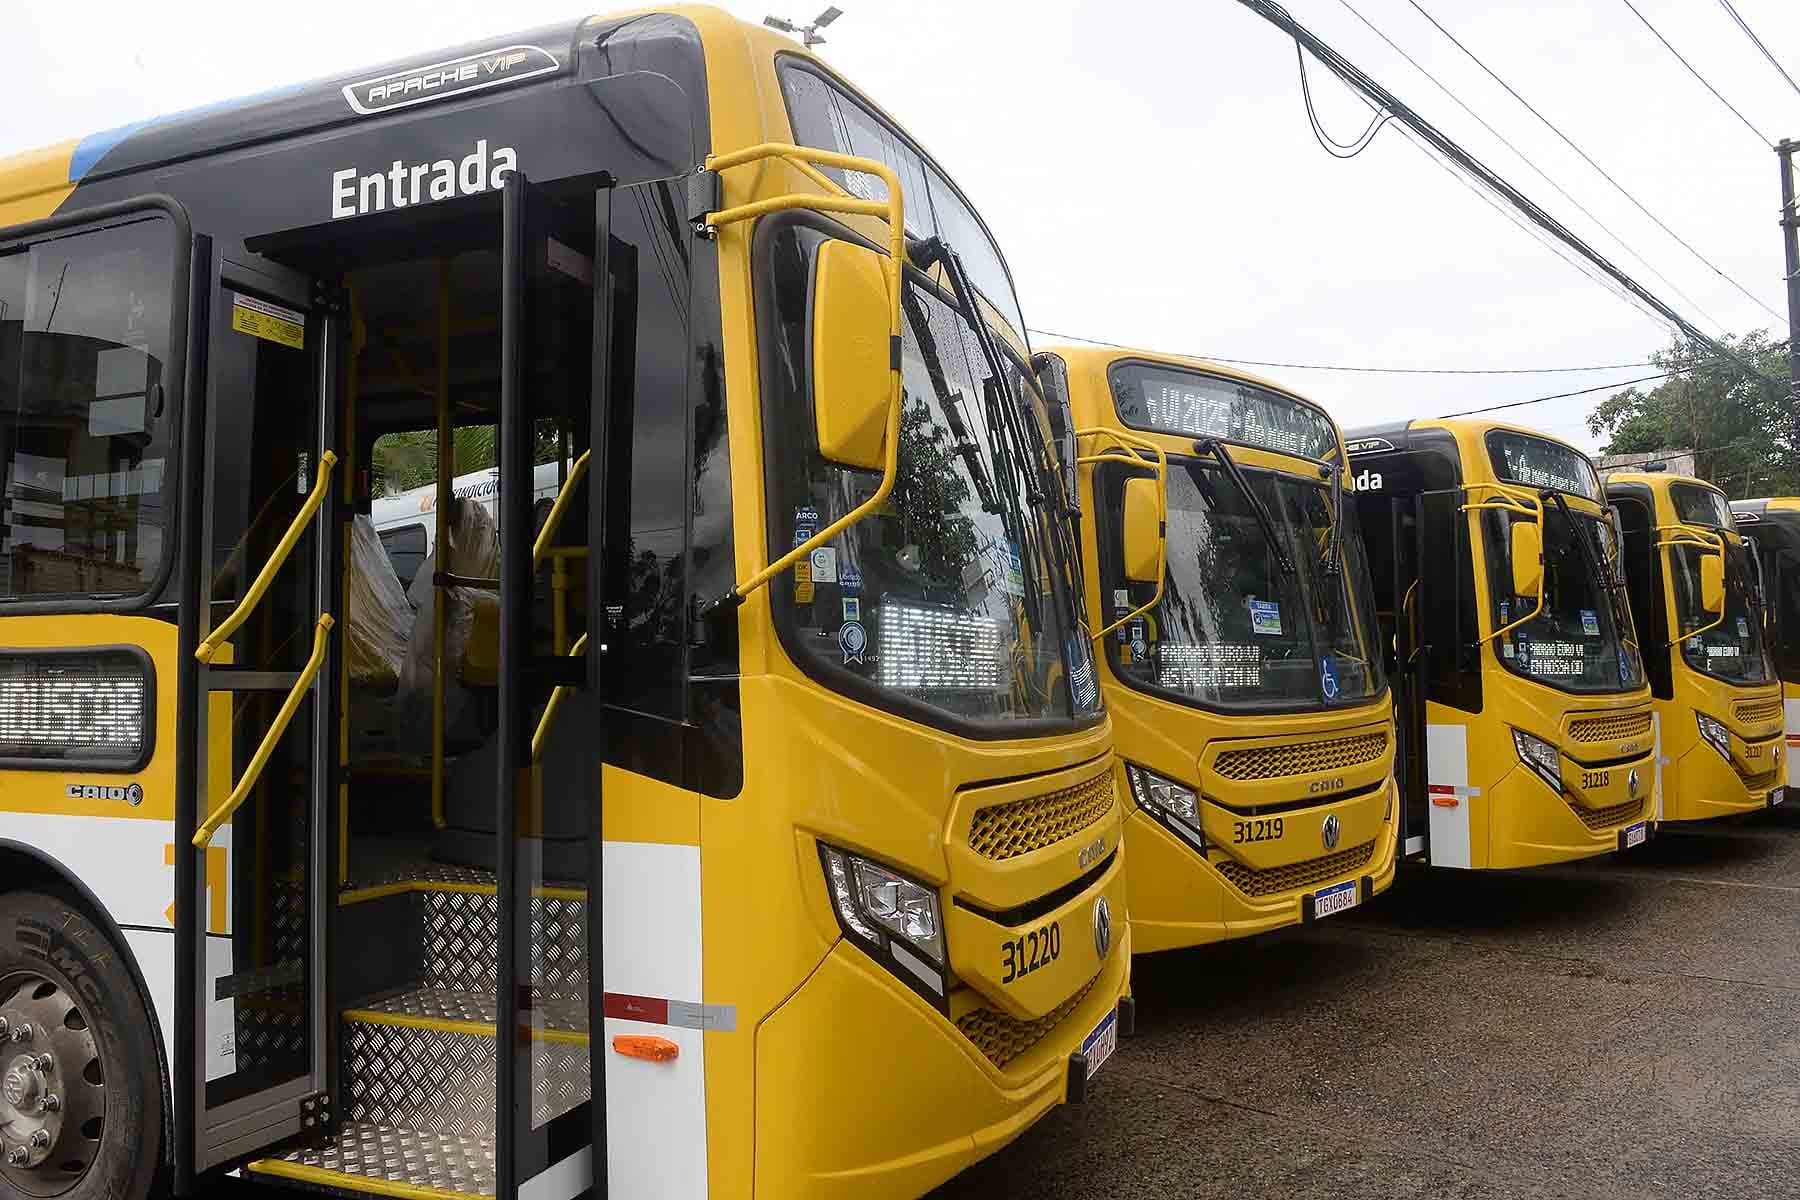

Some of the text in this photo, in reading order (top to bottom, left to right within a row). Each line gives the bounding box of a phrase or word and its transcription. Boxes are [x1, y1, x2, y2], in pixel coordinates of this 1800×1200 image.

[368, 51, 528, 103] APACHE VIP
[332, 139, 517, 219] Entrada
[65, 784, 125, 801] CAIO
[1582, 770, 1609, 790] 31218
[1233, 817, 1284, 844] 31219
[1001, 921, 1061, 985] 31220
